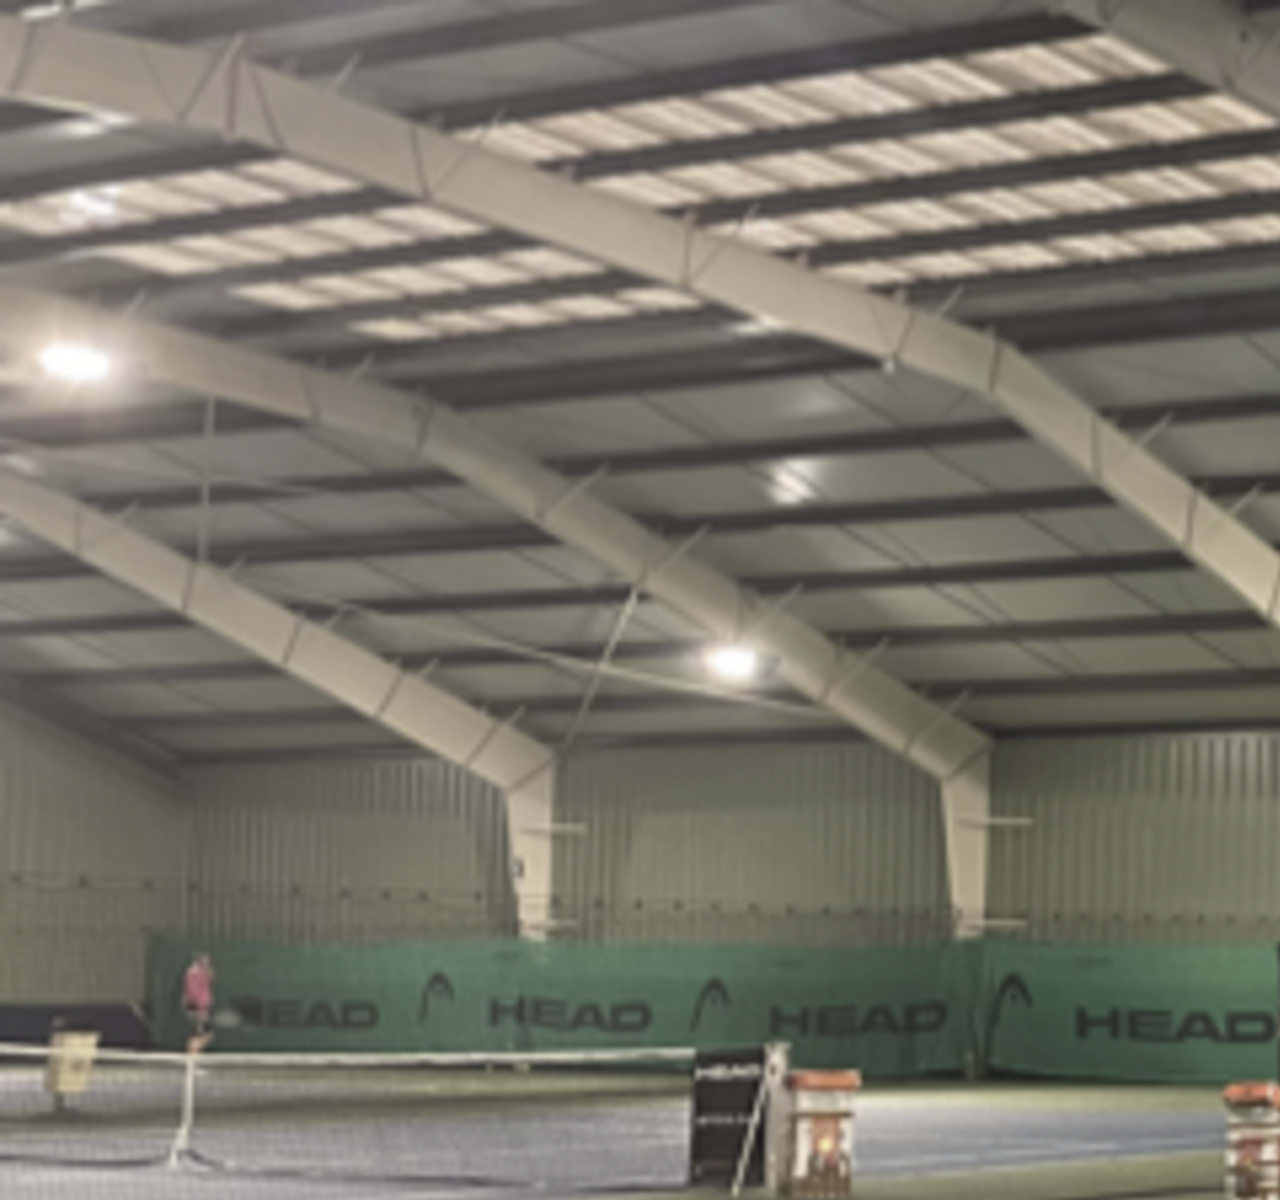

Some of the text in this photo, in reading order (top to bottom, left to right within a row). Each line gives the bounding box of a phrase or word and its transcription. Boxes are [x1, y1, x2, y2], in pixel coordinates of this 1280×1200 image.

[489, 996, 653, 1032] HEAD
[770, 1005, 948, 1037] HEAD
[1075, 1007, 1277, 1043] HEAD
